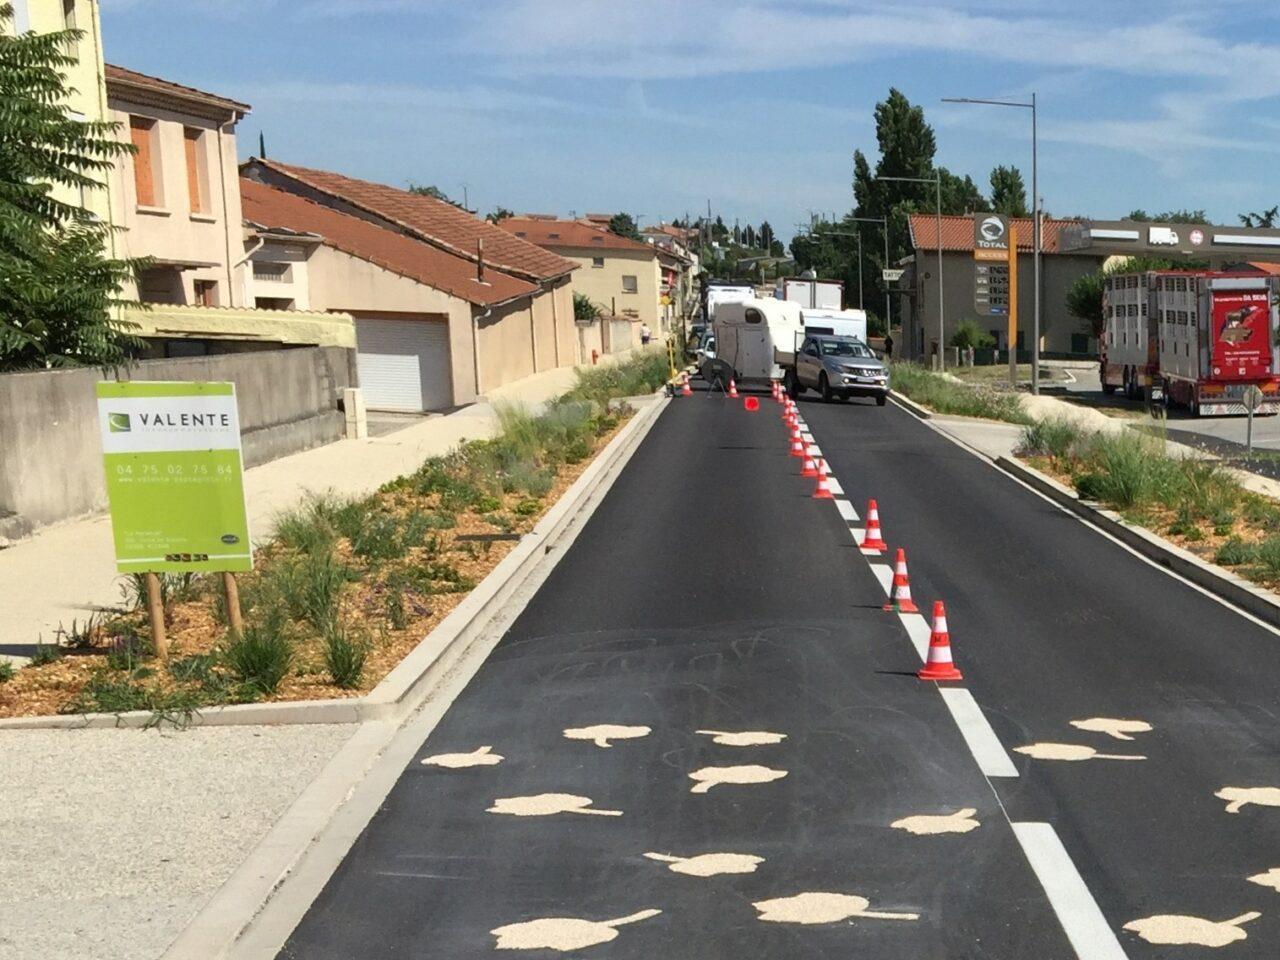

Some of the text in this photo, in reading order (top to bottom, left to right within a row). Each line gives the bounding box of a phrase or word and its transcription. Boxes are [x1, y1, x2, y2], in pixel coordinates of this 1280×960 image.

[978, 240, 1007, 249] TOTAL
[139, 413, 229, 426] VALENTE
[116, 464, 132, 474] 04
[167, 464, 183, 474] 02
